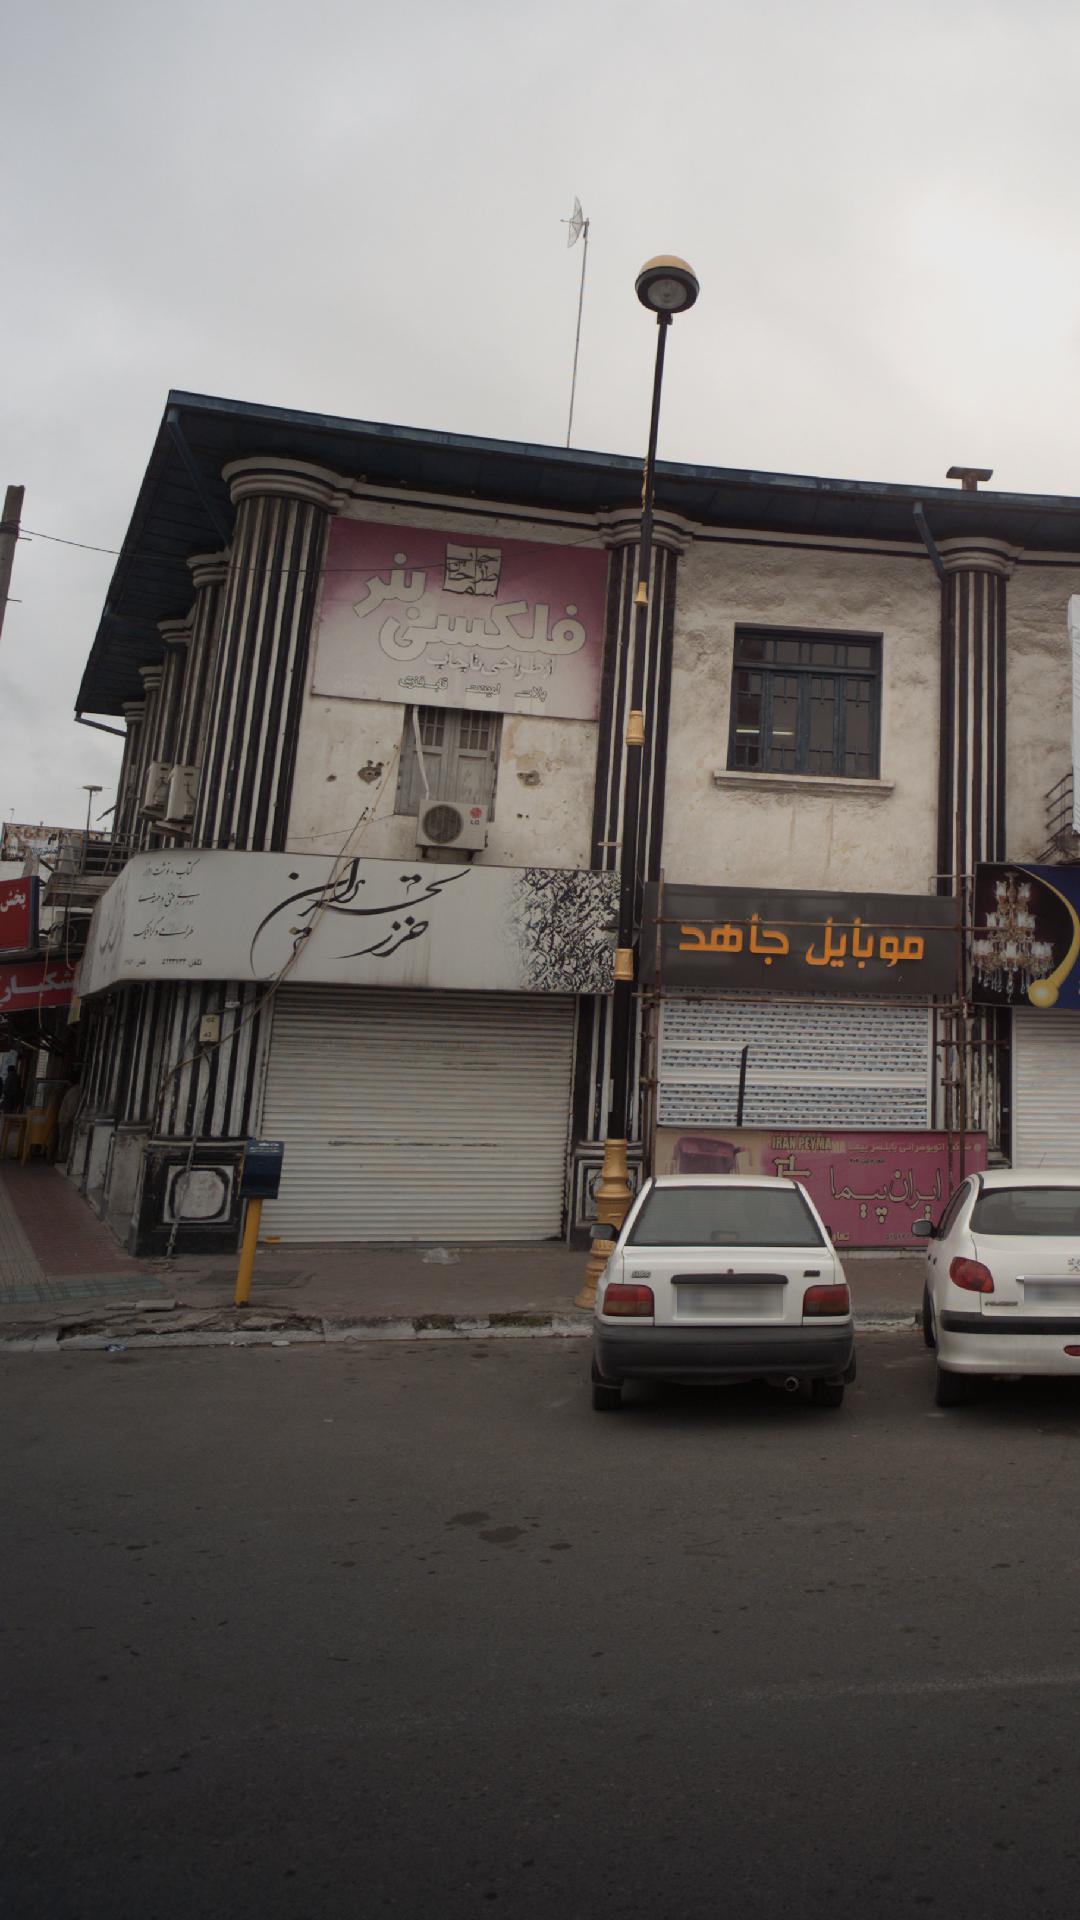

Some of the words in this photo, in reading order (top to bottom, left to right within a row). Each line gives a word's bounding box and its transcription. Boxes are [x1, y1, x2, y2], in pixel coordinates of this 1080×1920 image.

[378, 600, 586, 661] فلکسی
[425, 650, 468, 672] چاپ
[483, 655, 543, 680] طراحی
[678, 912, 790, 965] جاهد
[805, 916, 926, 968] موبایل
[771, 1135, 796, 1150] IRAN
[798, 1135, 832, 1150] PEYMA
[829, 1165, 889, 1224] پیما
[888, 1167, 942, 1220] ایران
